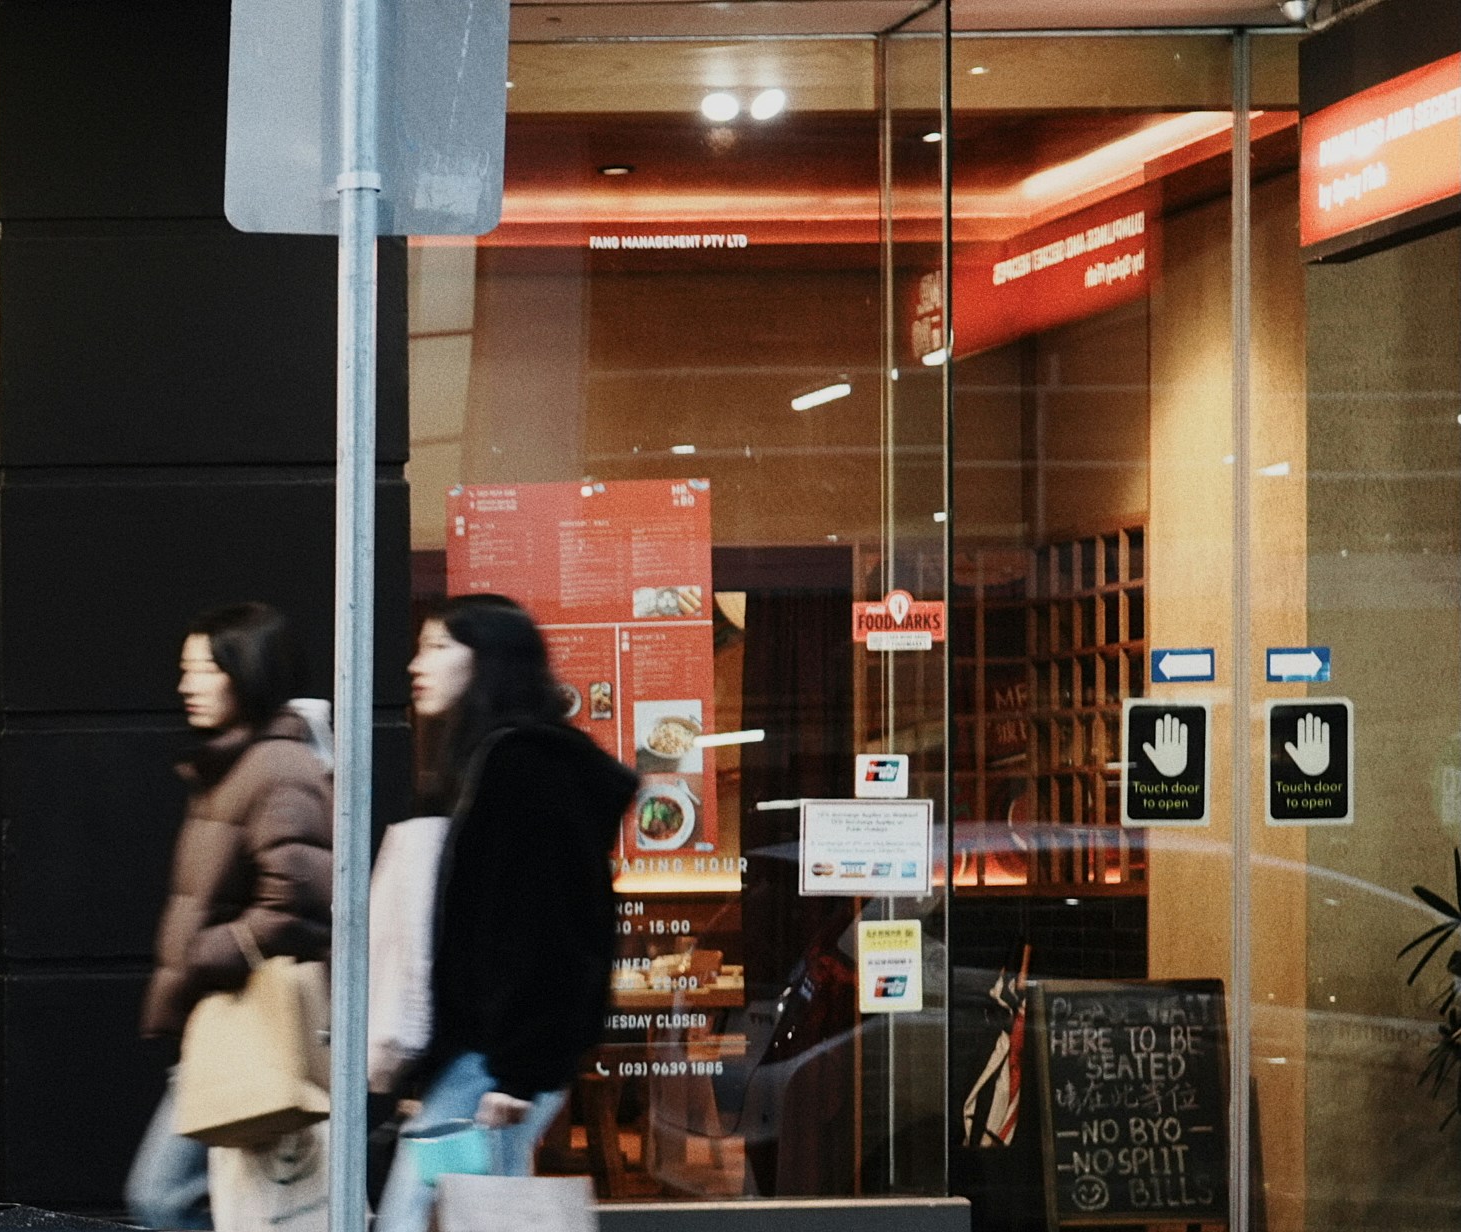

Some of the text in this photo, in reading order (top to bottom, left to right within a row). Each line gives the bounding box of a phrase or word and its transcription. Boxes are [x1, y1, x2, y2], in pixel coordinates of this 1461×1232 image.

[621, 234, 701, 249] MANAGEMENT
[703, 234, 725, 248] PTY
[727, 234, 747, 248] LTD
[1133, 781, 1200, 794] Touch door
[1276, 780, 1343, 793] Touch door
[1143, 798, 1189, 811] to open
[1286, 797, 1332, 810] to open
[649, 920, 691, 935] 15:00
[655, 1013, 707, 1029] CLOSED
[1050, 1026, 1205, 1057] HERE TO BE
[618, 1061, 724, 1077] (03) 9639 1885
[1085, 1052, 1186, 1081] SEATED
[1129, 1117, 1182, 1144] BYO
[1118, 1145, 1189, 1175] SPLIT
[1129, 1175, 1213, 1207] BILLS
